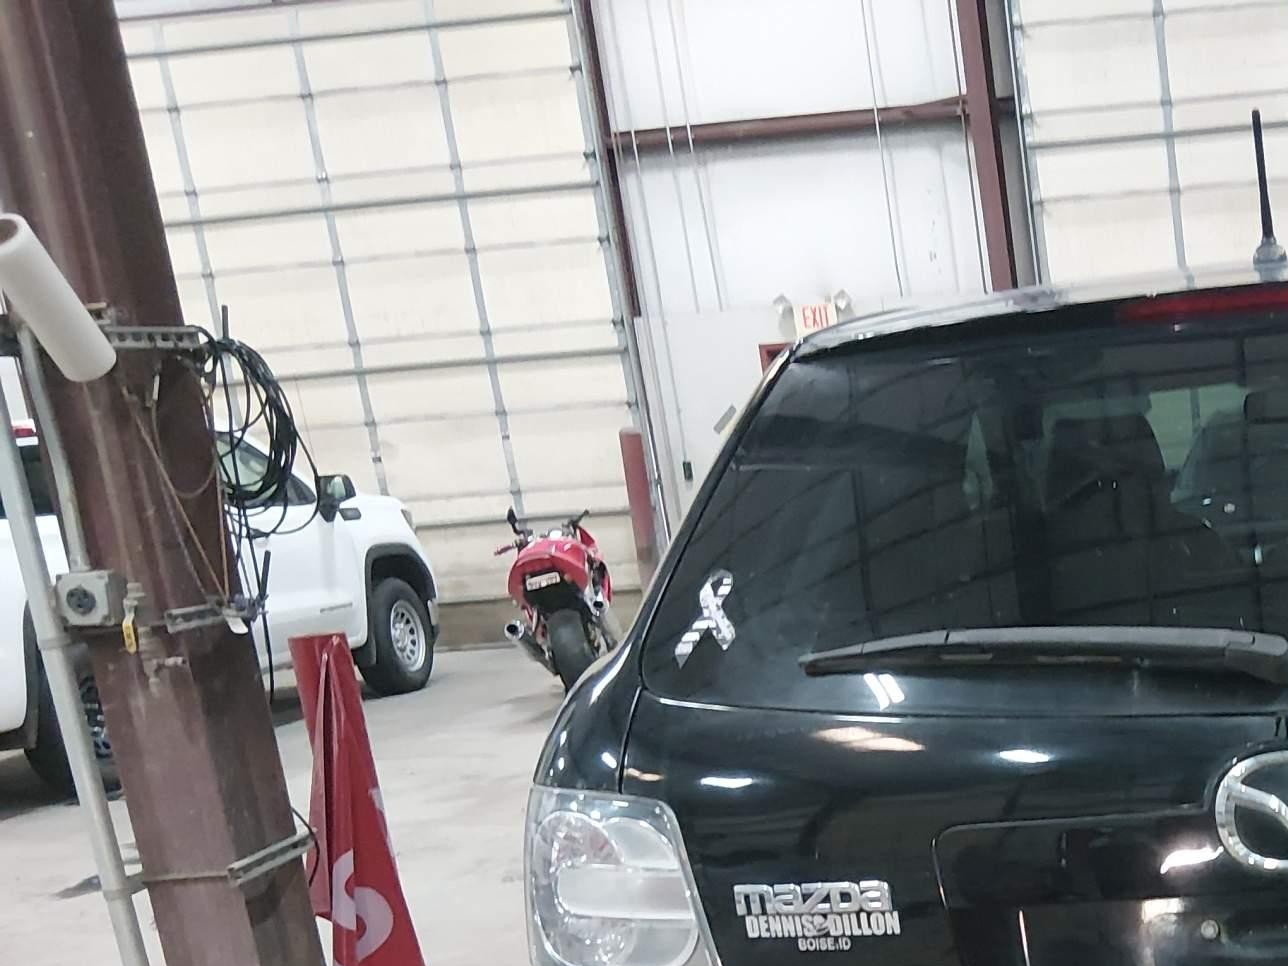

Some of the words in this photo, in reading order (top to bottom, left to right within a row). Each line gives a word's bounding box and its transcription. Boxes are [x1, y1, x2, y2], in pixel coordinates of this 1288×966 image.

[802, 304, 829, 329] EXIT
[745, 912, 816, 938] DENNIS
[828, 911, 901, 937] DILLON
